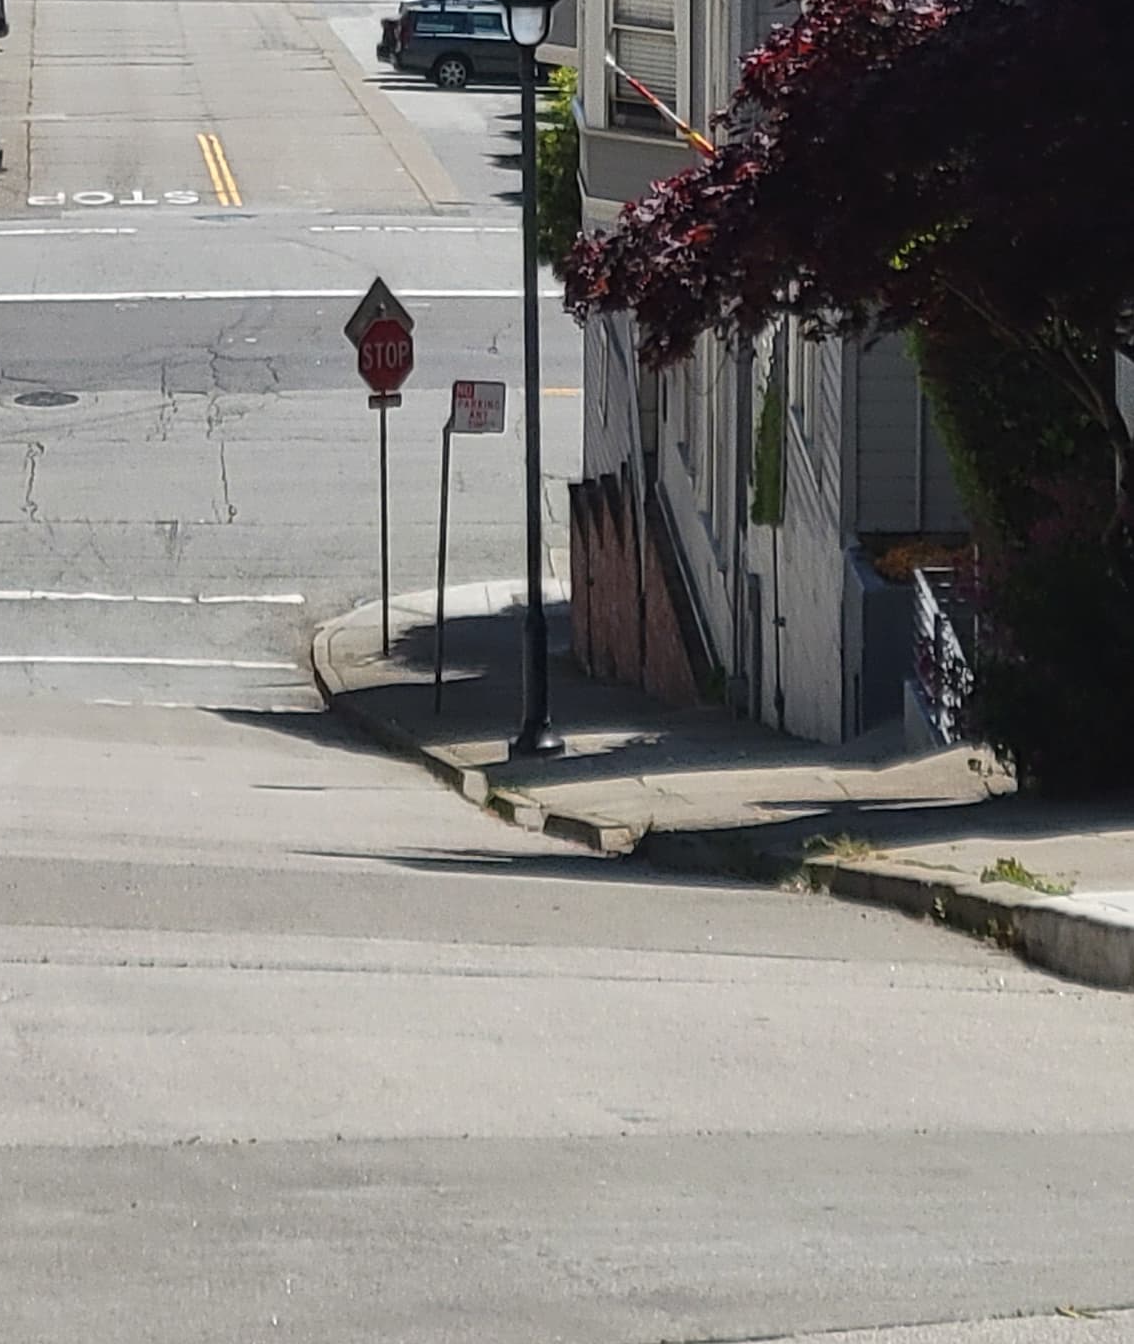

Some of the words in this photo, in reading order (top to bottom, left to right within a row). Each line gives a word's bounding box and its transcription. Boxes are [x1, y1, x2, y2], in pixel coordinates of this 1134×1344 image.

[27, 189, 199, 205] STOP
[363, 341, 410, 369] STOP
[457, 384, 474, 398] NO
[457, 399, 501, 409] PARKING
